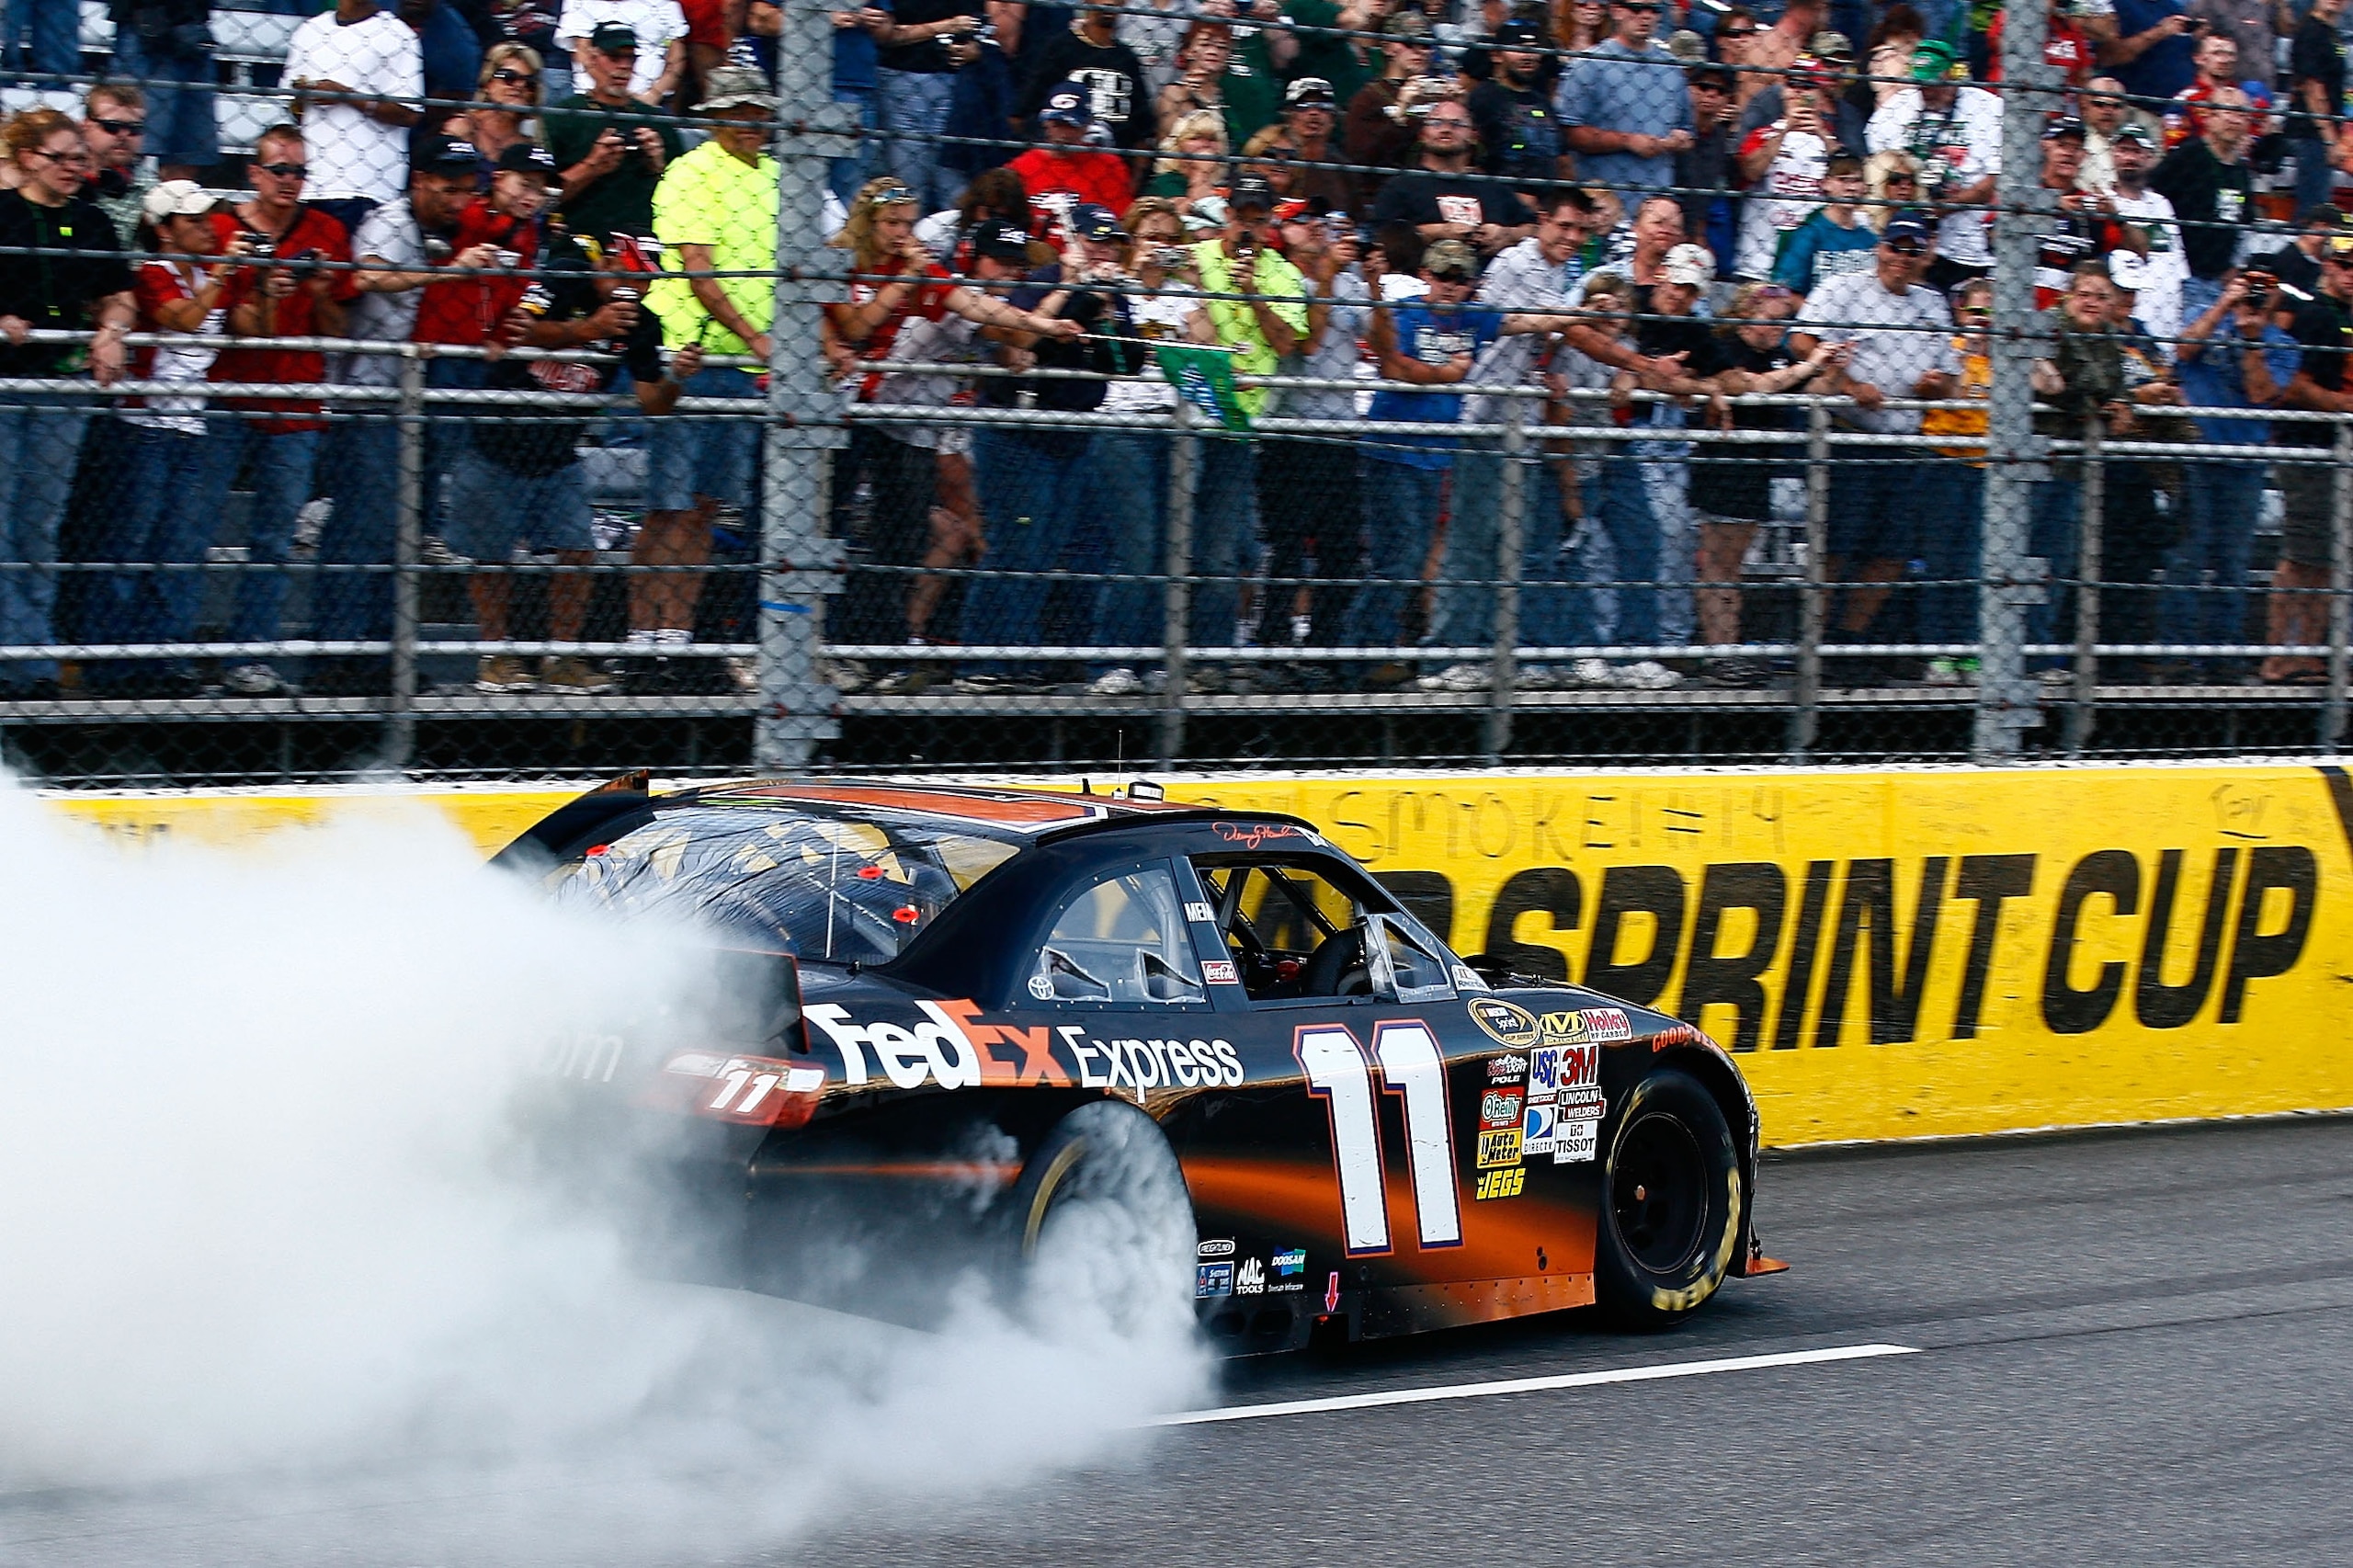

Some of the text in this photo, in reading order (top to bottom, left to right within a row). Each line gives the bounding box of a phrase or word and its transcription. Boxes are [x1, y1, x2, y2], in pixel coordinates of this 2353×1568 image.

[1483, 852, 2040, 1054] SPRINT
[2041, 846, 2319, 1034] CUP
[1584, 1010, 1630, 1037] Holley
[801, 999, 1245, 1103] FedEx Express
[1561, 1046, 1595, 1085] 3M
[709, 1068, 781, 1114] 11
[1491, 1075, 1520, 1085] POLE
[1483, 1094, 1520, 1119] O'Reilly
[1561, 1090, 1597, 1104] LINCOLN
[1567, 1106, 1600, 1118] WELDERS
[1292, 1018, 1465, 1259] 11
[1491, 1133, 1515, 1147] Auto
[1557, 1138, 1596, 1153] TISSOT
[1488, 1146, 1519, 1161] Meter
[1476, 1168, 1526, 1199] JEGS
[1237, 1257, 1265, 1285] MAC
[1271, 1254, 1305, 1266] DOOSAN
[1236, 1284, 1264, 1295] TOOLS
